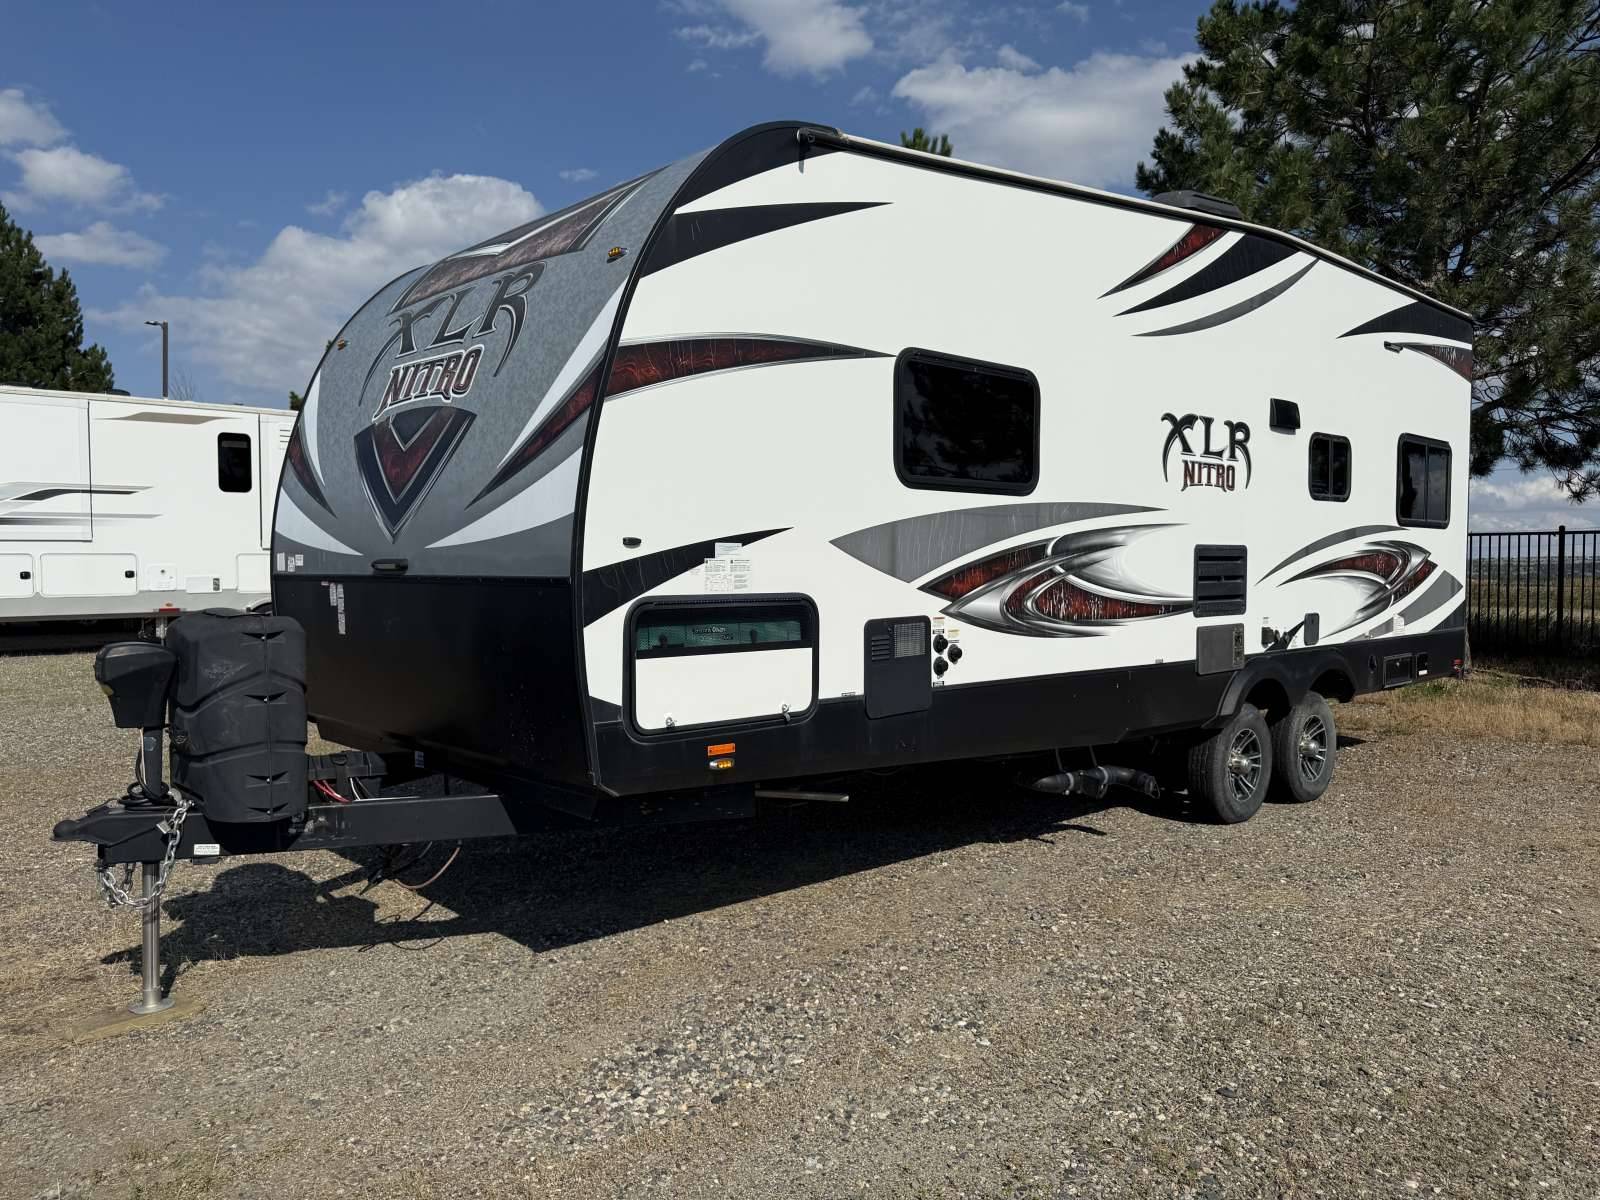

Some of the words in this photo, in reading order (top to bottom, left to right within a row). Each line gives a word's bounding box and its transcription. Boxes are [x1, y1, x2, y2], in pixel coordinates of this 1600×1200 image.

[358, 261, 547, 407] XLR
[372, 344, 484, 421] NITRO
[1160, 412, 1252, 489] XLR
[1180, 459, 1236, 492] NITRO
